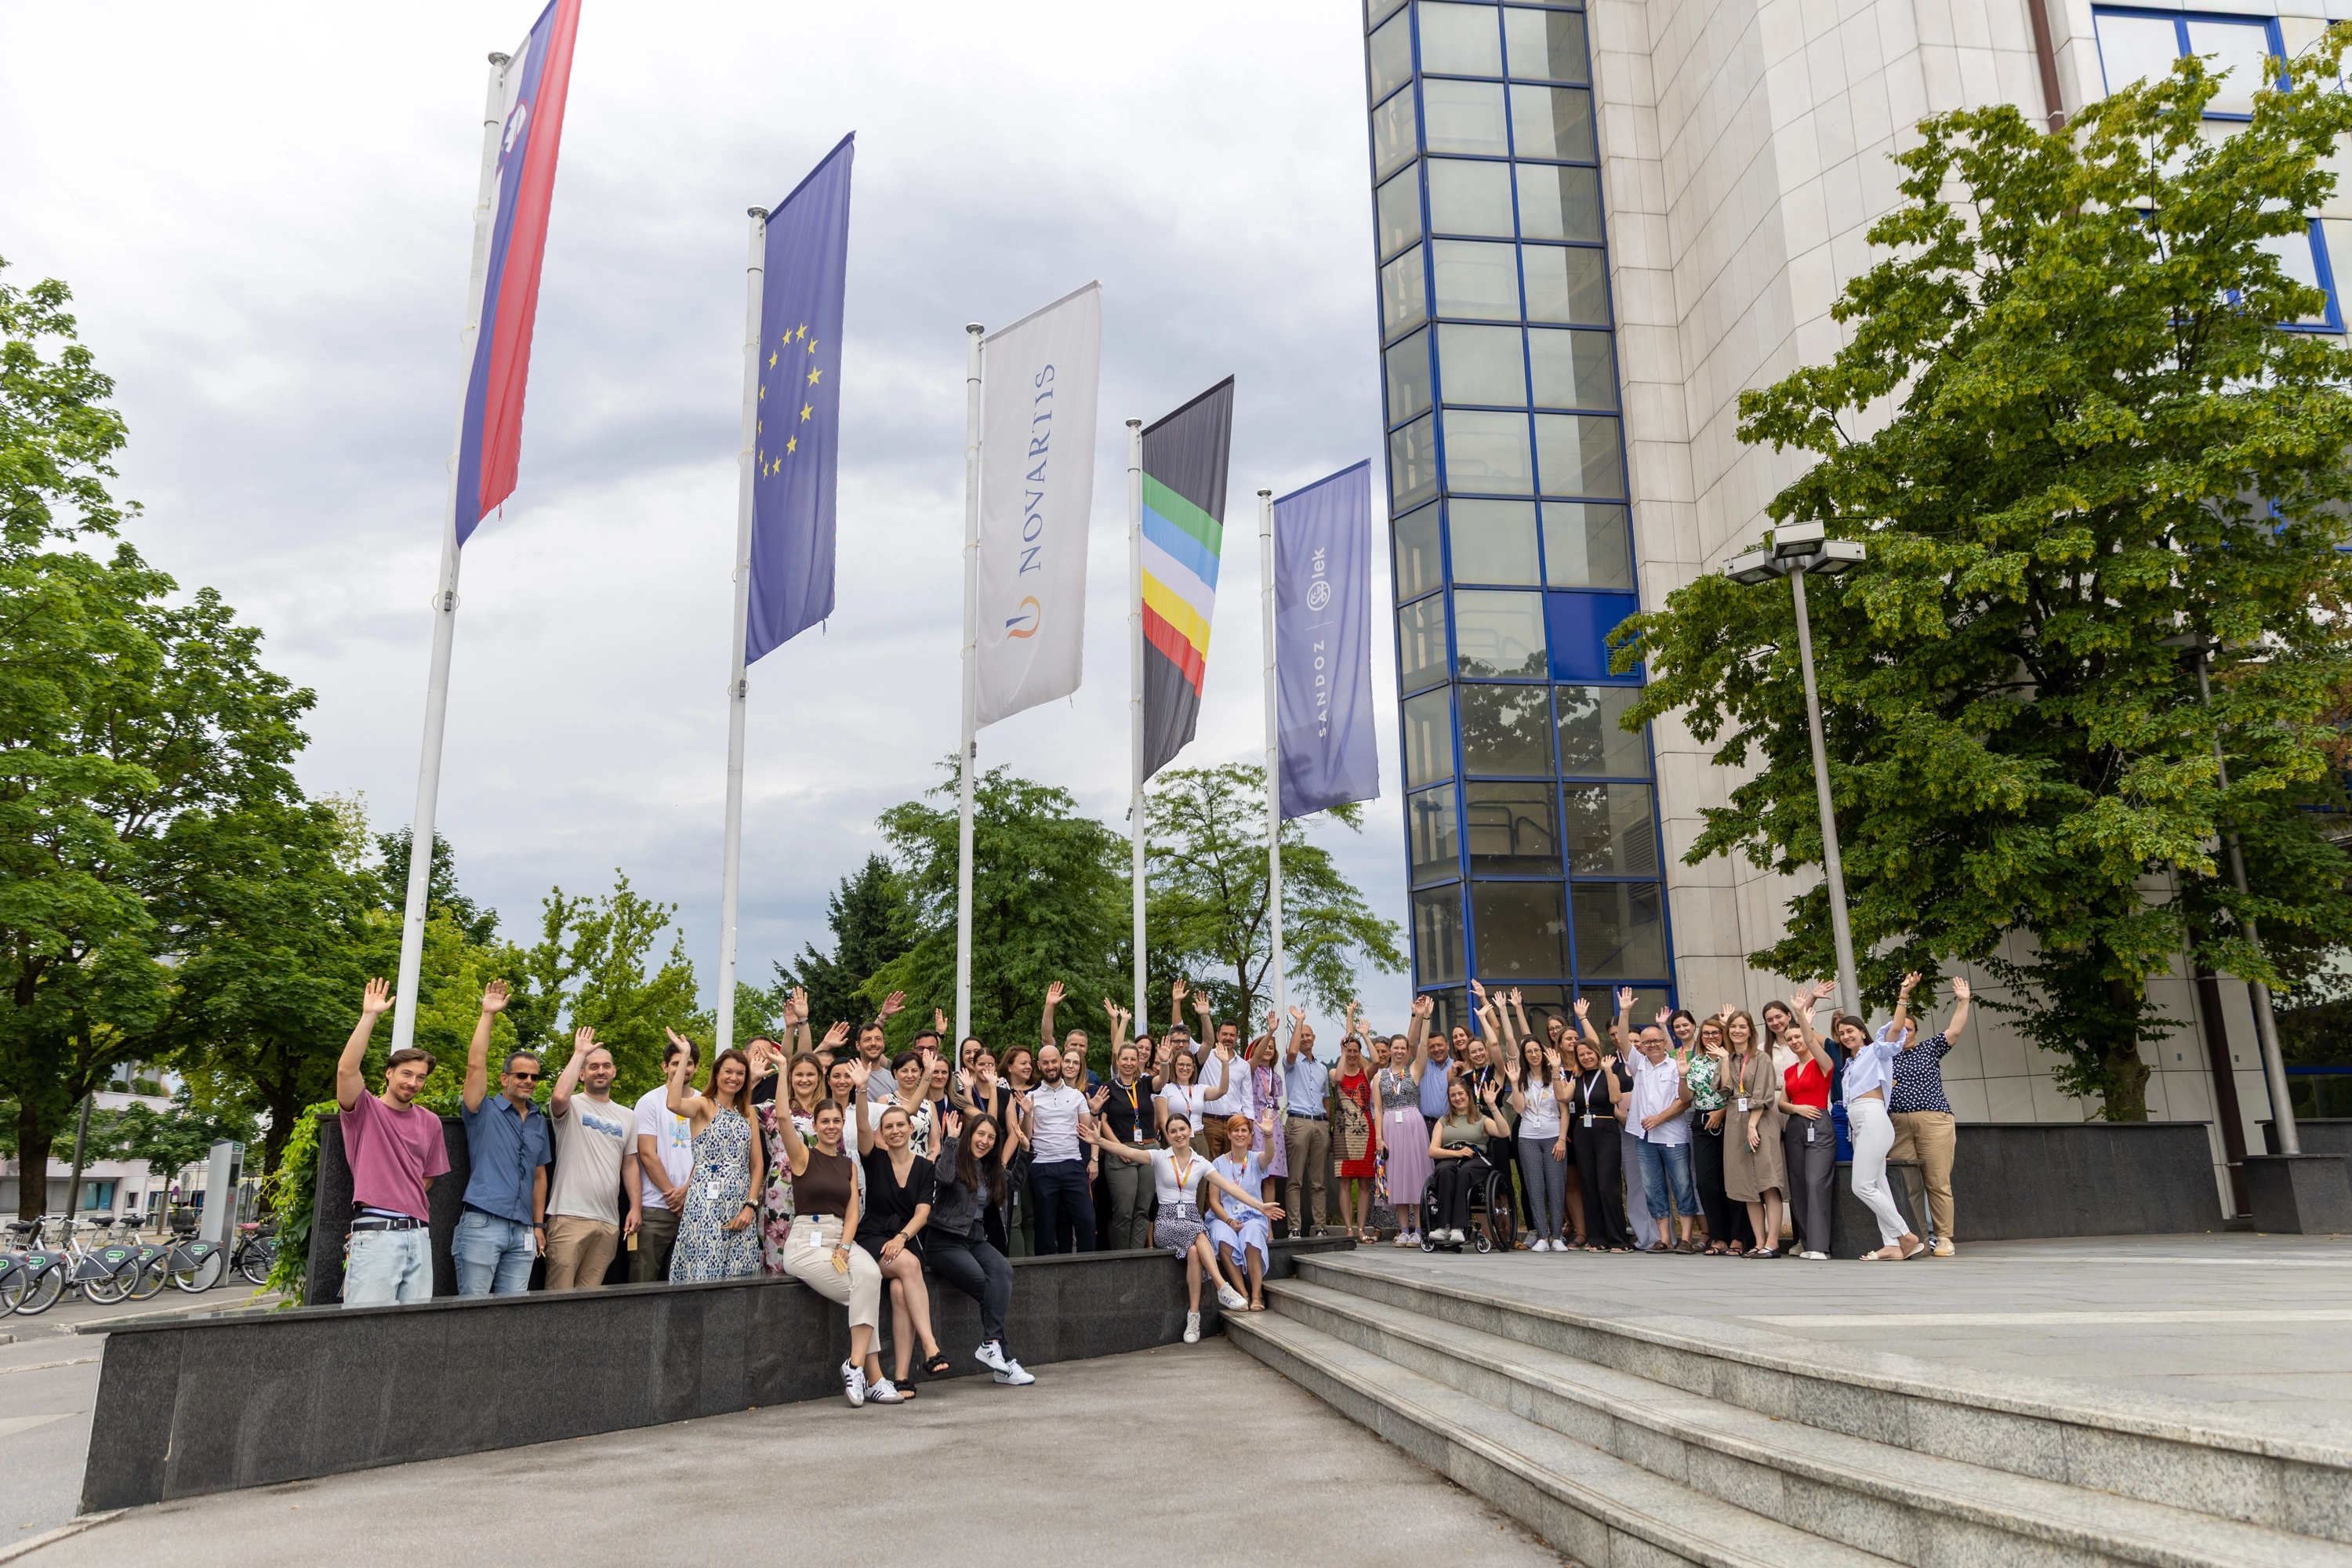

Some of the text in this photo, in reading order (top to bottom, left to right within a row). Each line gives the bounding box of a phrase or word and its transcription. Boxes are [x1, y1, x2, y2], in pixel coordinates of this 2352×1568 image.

[1018, 364, 1055, 578] NOVARTIS
[1311, 546, 1327, 738] SANDOZ lek
